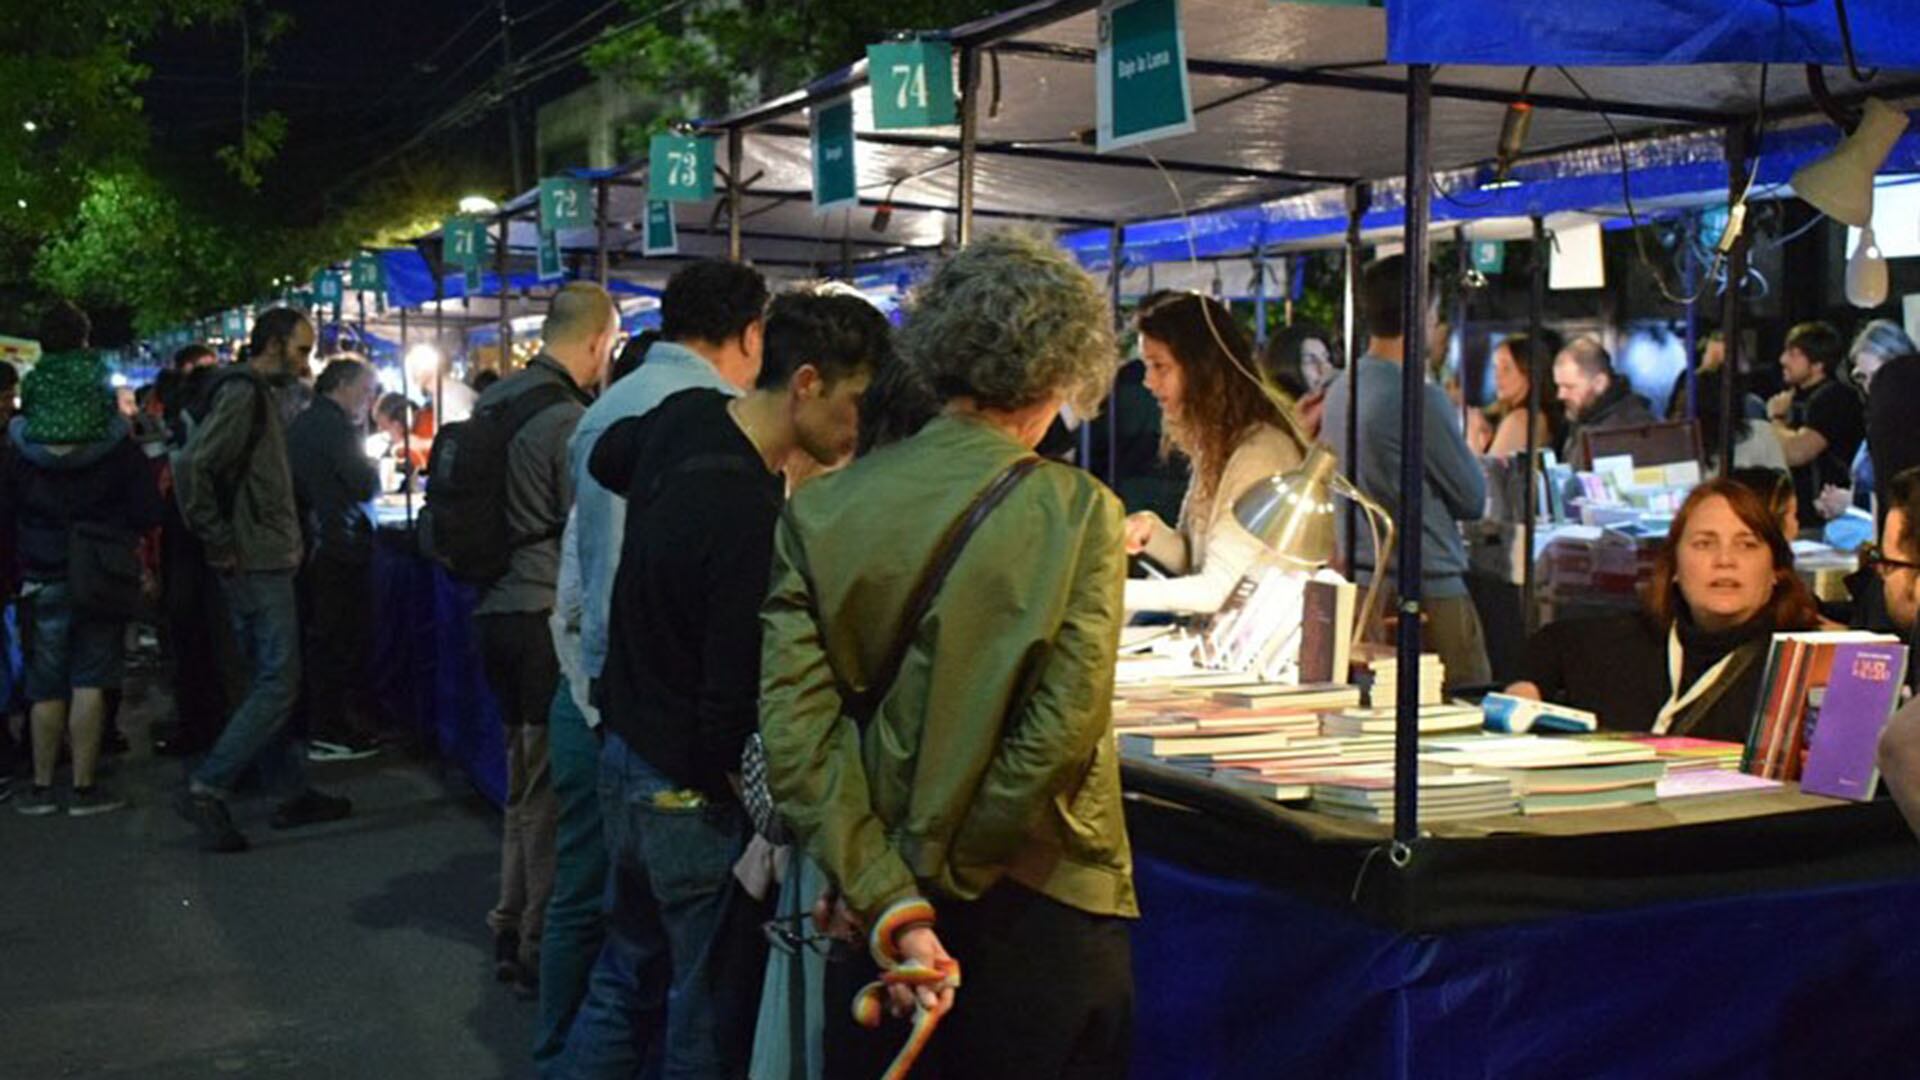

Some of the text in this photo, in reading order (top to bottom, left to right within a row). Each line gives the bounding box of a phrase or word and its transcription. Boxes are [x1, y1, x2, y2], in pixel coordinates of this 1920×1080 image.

[891, 63, 928, 109] 74
[667, 152, 697, 187] 73
[552, 189, 578, 218] 72
[454, 229, 473, 254] 71
